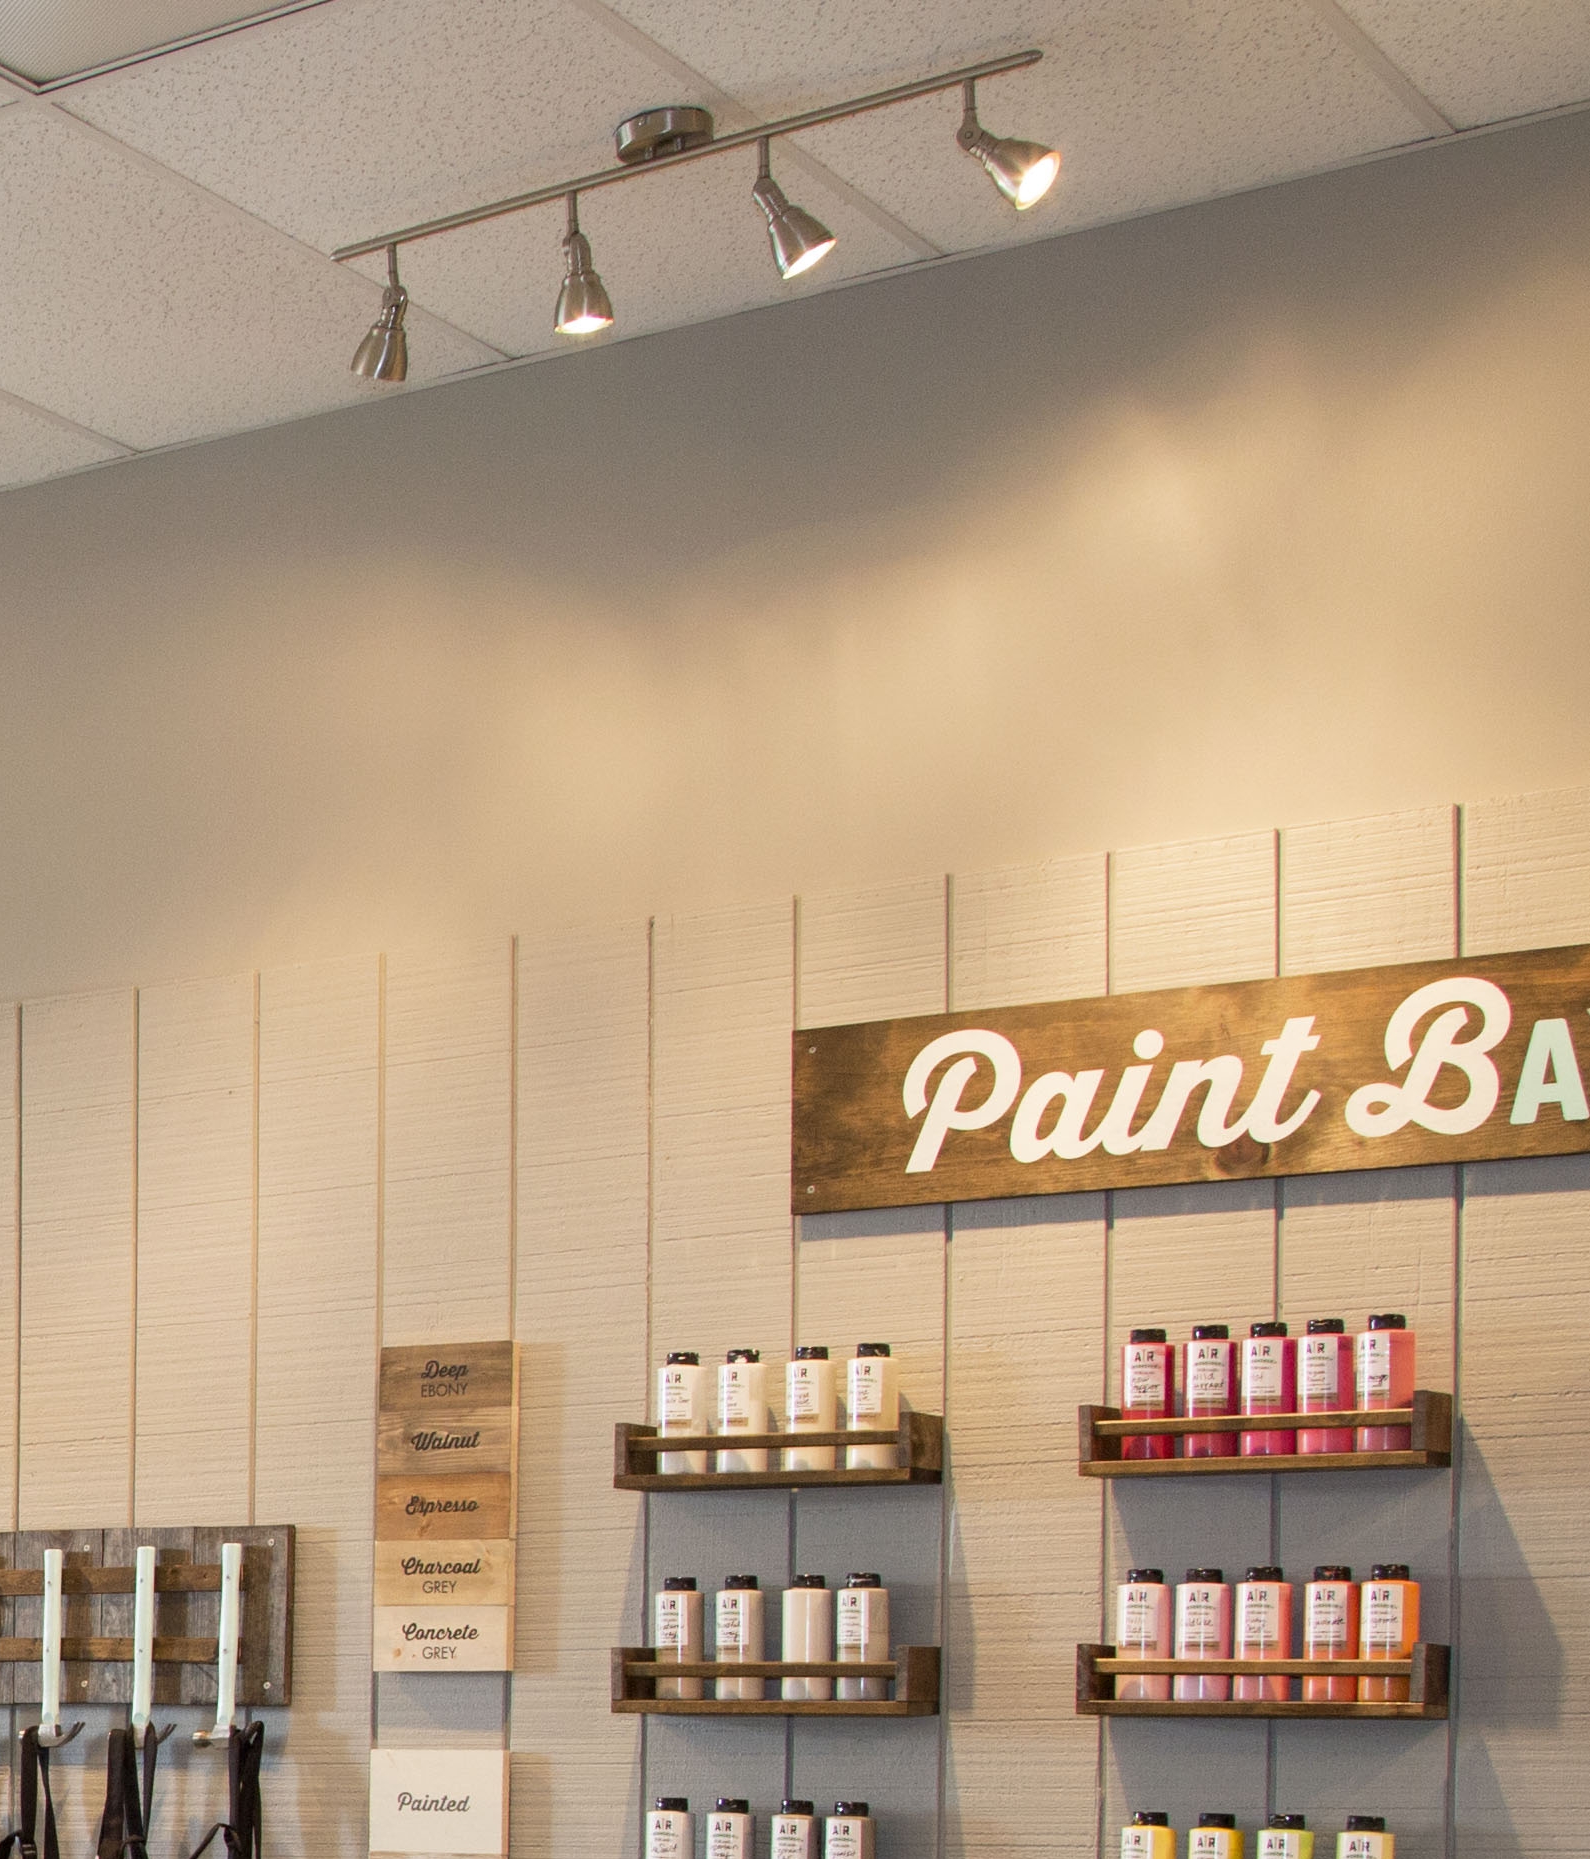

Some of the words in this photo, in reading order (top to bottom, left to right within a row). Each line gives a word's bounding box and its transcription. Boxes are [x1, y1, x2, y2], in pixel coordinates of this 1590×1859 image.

[903, 1028, 1323, 1174] Paint
[1344, 976, 1590, 1139] BA
[421, 1359, 470, 1382] Deep
[421, 1382, 469, 1398] EBONY
[410, 1430, 481, 1452] Walnut
[405, 1496, 480, 1516] Espresso
[400, 1556, 481, 1577] Charcoal
[421, 1579, 458, 1594] GREY
[401, 1622, 480, 1643] Concrete
[421, 1645, 458, 1660] GREY
[397, 1790, 471, 1814] Painted
